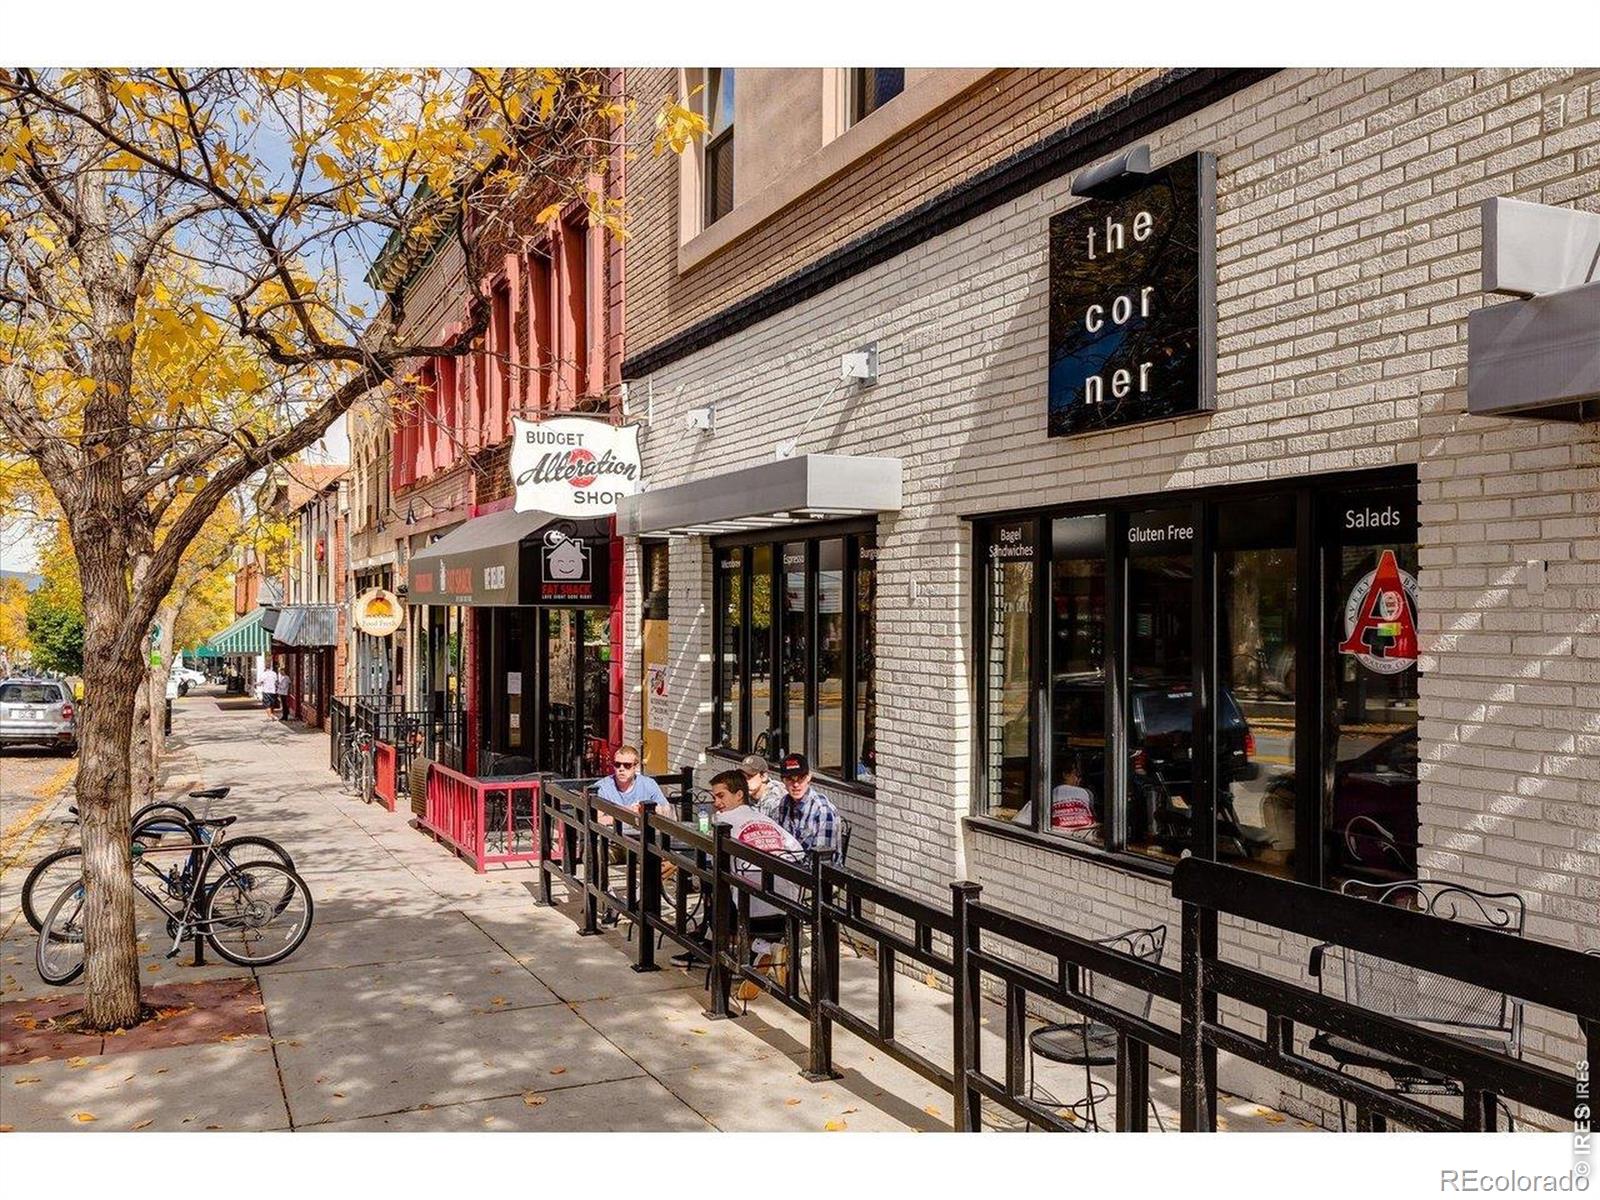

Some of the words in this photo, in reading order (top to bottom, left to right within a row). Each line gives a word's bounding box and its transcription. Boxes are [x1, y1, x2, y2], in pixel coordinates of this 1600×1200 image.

[1087, 211, 1153, 260] the
[1085, 286, 1154, 333] cor
[1085, 362, 1153, 404] ner
[526, 431, 584, 446] BUDGET
[517, 449, 637, 486] Alteration
[574, 491, 624, 504] SHOP
[1345, 506, 1400, 528] Salads
[1000, 528, 1022, 544] Bagel
[1128, 527, 1165, 543] Gluten
[1168, 525, 1194, 540] Free
[989, 544, 1034, 558] Sandwiches
